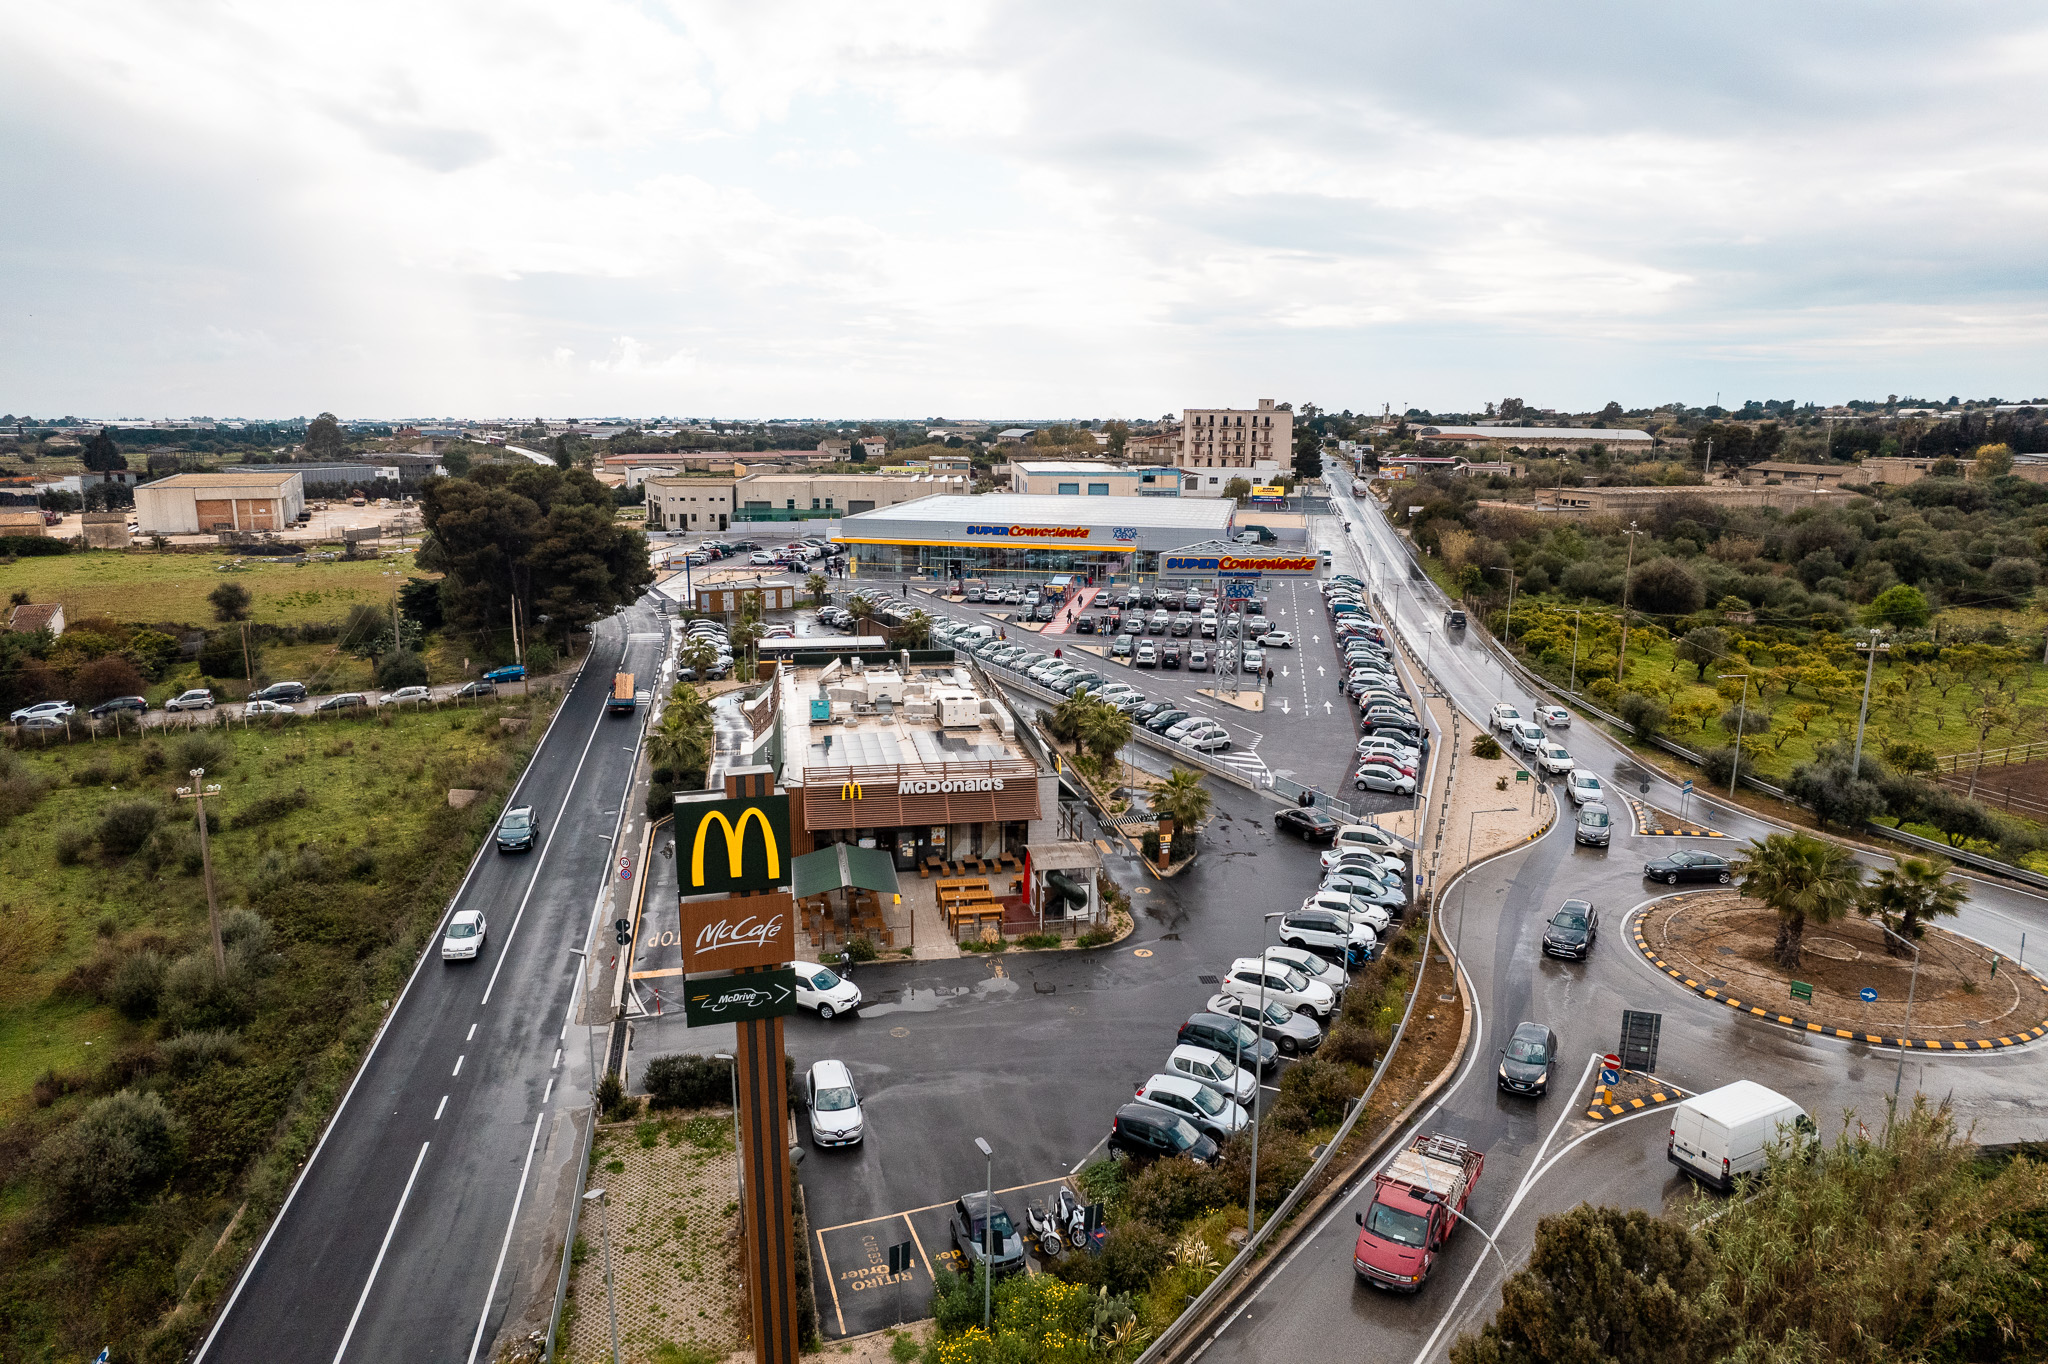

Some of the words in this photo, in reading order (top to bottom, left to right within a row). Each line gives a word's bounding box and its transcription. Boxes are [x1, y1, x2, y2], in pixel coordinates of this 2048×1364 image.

[1166, 556, 1318, 571] SUPERConveniente
[1226, 590, 1255, 598] ARENA
[898, 778, 1004, 794] McDonald's
[648, 930, 682, 947] TOP
[695, 913, 784, 949] McCafé
[718, 992, 757, 1004] McDrive
[841, 1264, 890, 1280] Order
[851, 1271, 913, 1291] RITIRO
